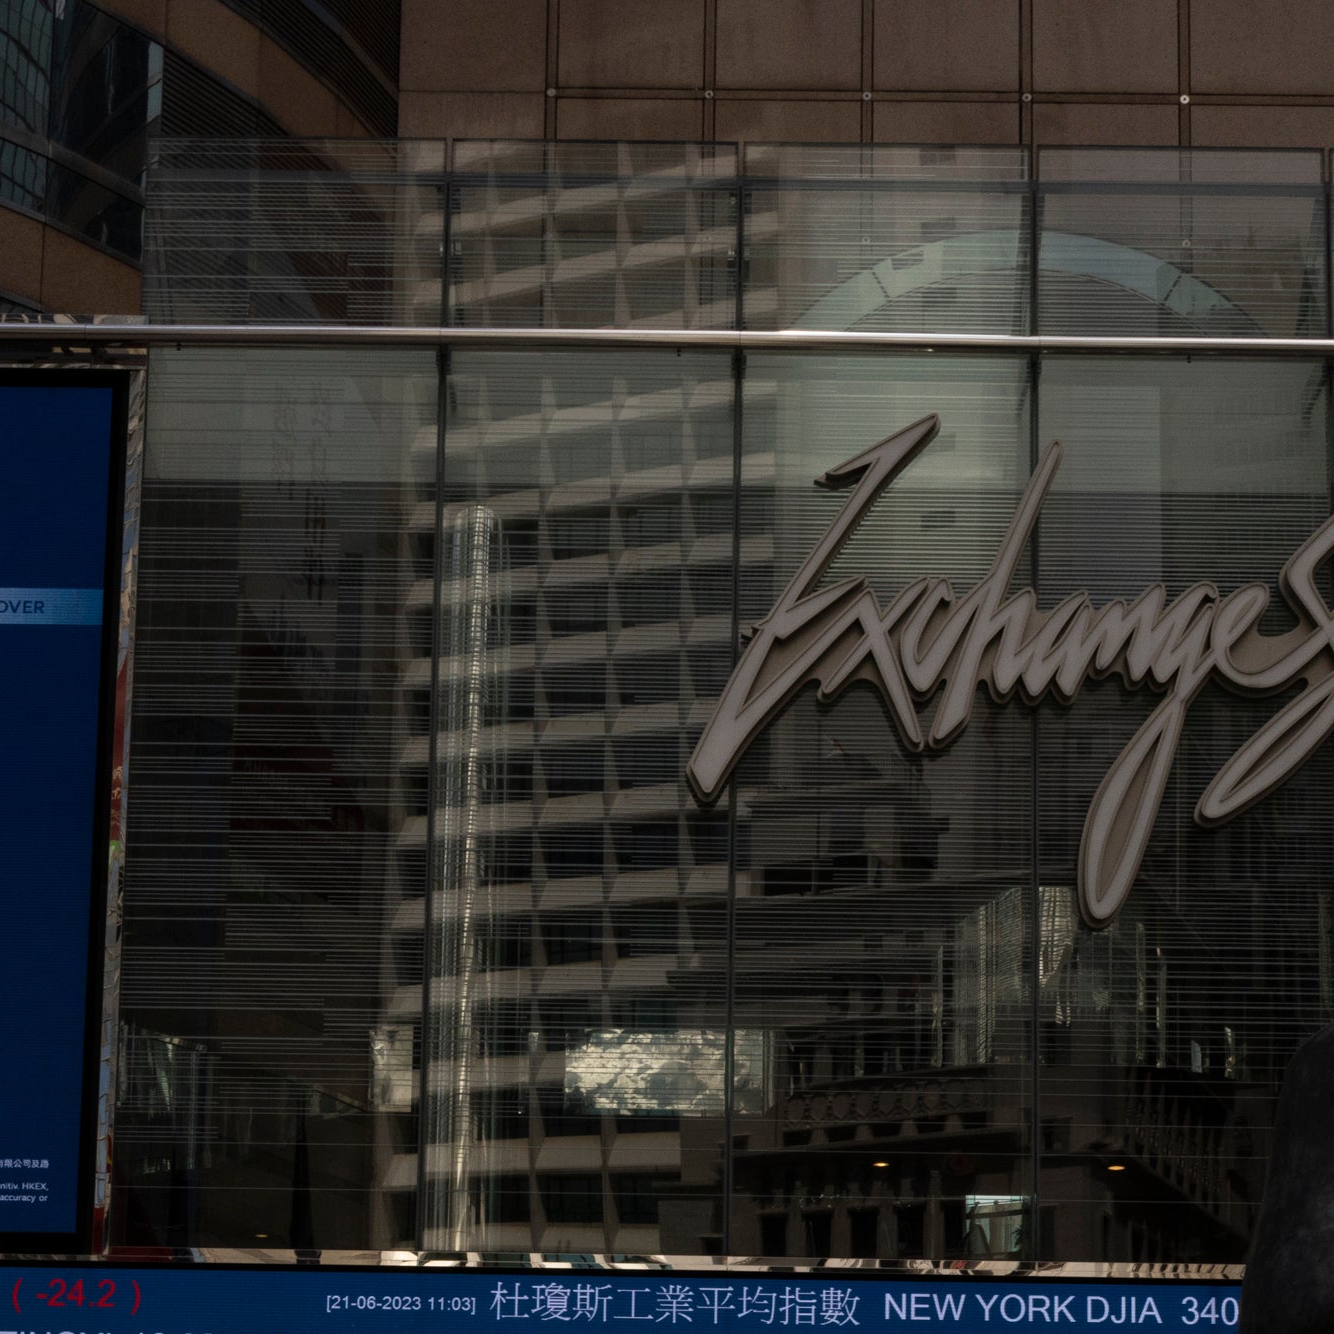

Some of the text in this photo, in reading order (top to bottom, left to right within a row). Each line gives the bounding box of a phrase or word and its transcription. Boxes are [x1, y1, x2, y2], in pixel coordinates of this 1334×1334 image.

[685, 413, 1272, 928] Exchange
[428, 1297, 475, 1315] 11:03]
[490, 1282, 860, 1326] 杜瓊斯工業平均指數
[885, 1293, 966, 1320] NEW
[975, 1294, 1075, 1322] YORK
[1087, 1296, 1163, 1323] DJIA
